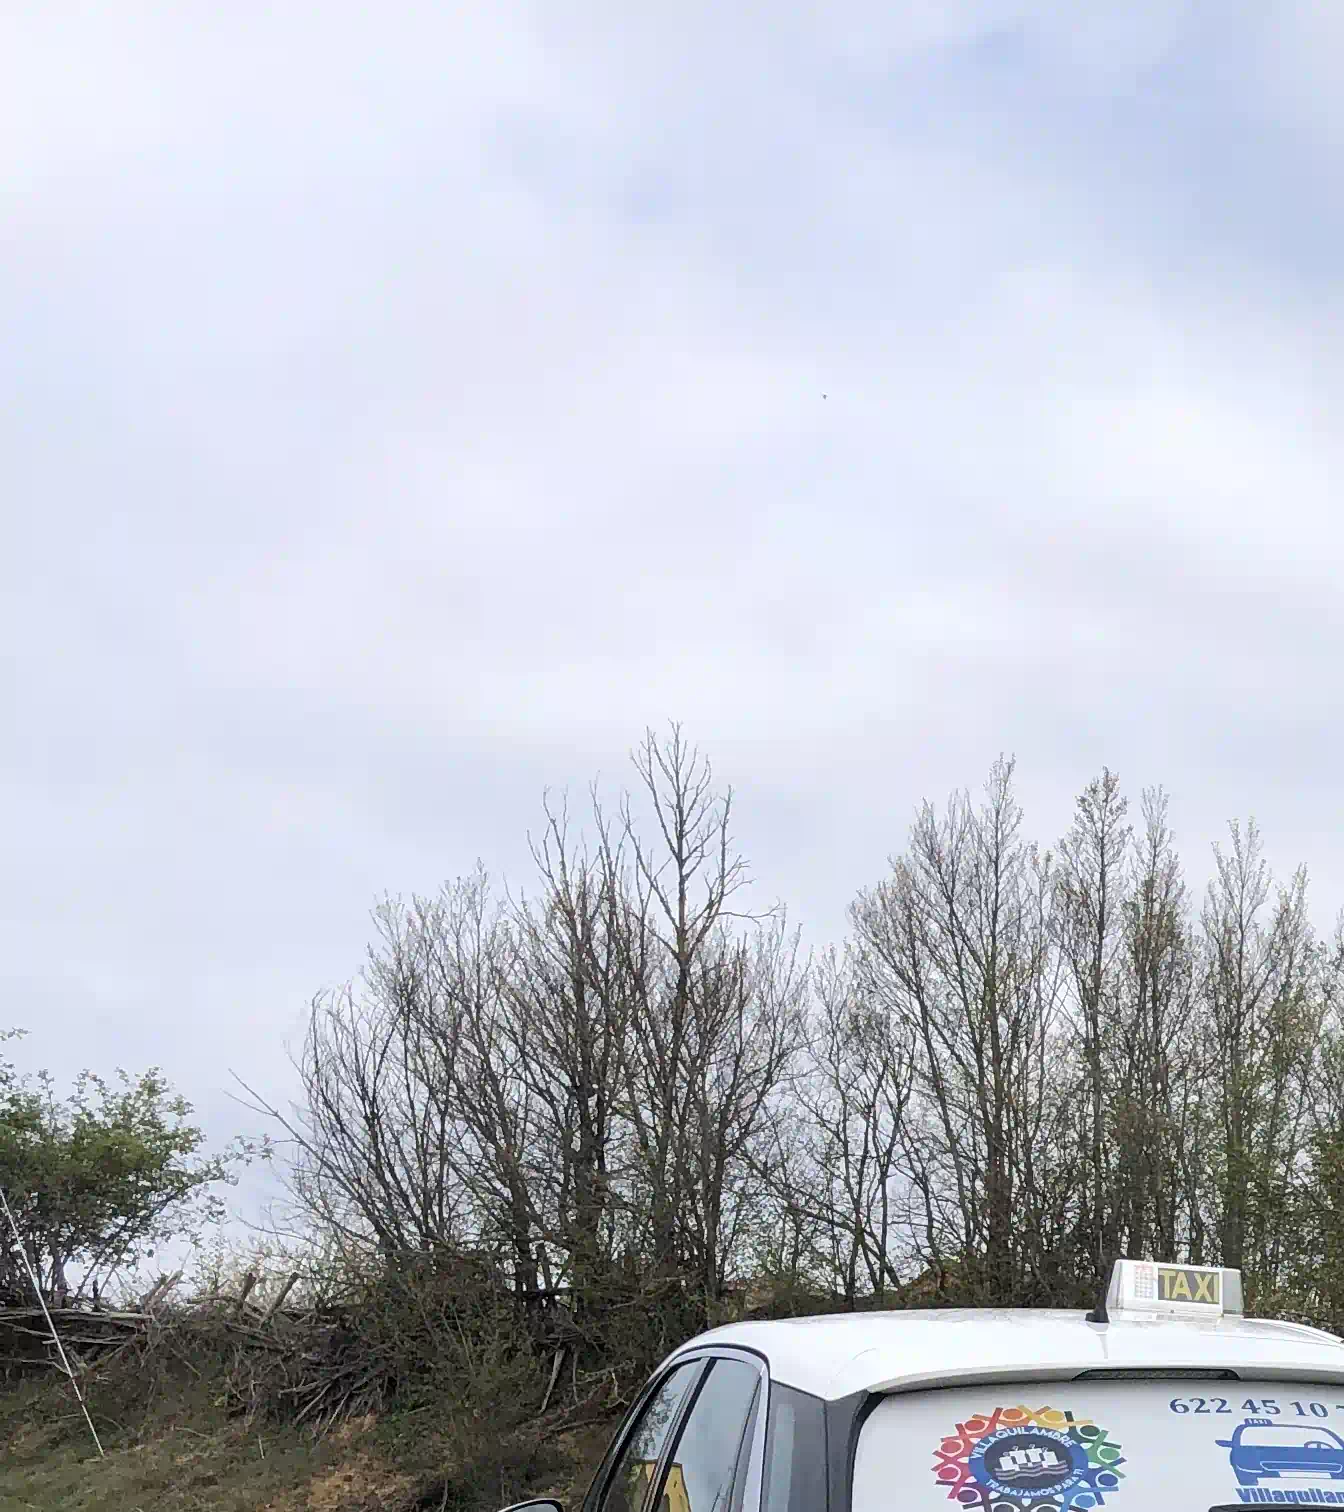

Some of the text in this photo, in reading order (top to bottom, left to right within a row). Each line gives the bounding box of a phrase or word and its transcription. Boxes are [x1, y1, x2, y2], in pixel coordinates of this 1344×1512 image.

[1158, 1269, 1219, 1303] TAXI
[1169, 1397, 1232, 1414] 622
[1241, 1398, 1281, 1415] 45
[1289, 1401, 1329, 1418] 10
[971, 1426, 1078, 1460] VILLAQUILAMBRE
[985, 1478, 1056, 1497] TRABAJAMOS
[1054, 1475, 1080, 1492] PARA
